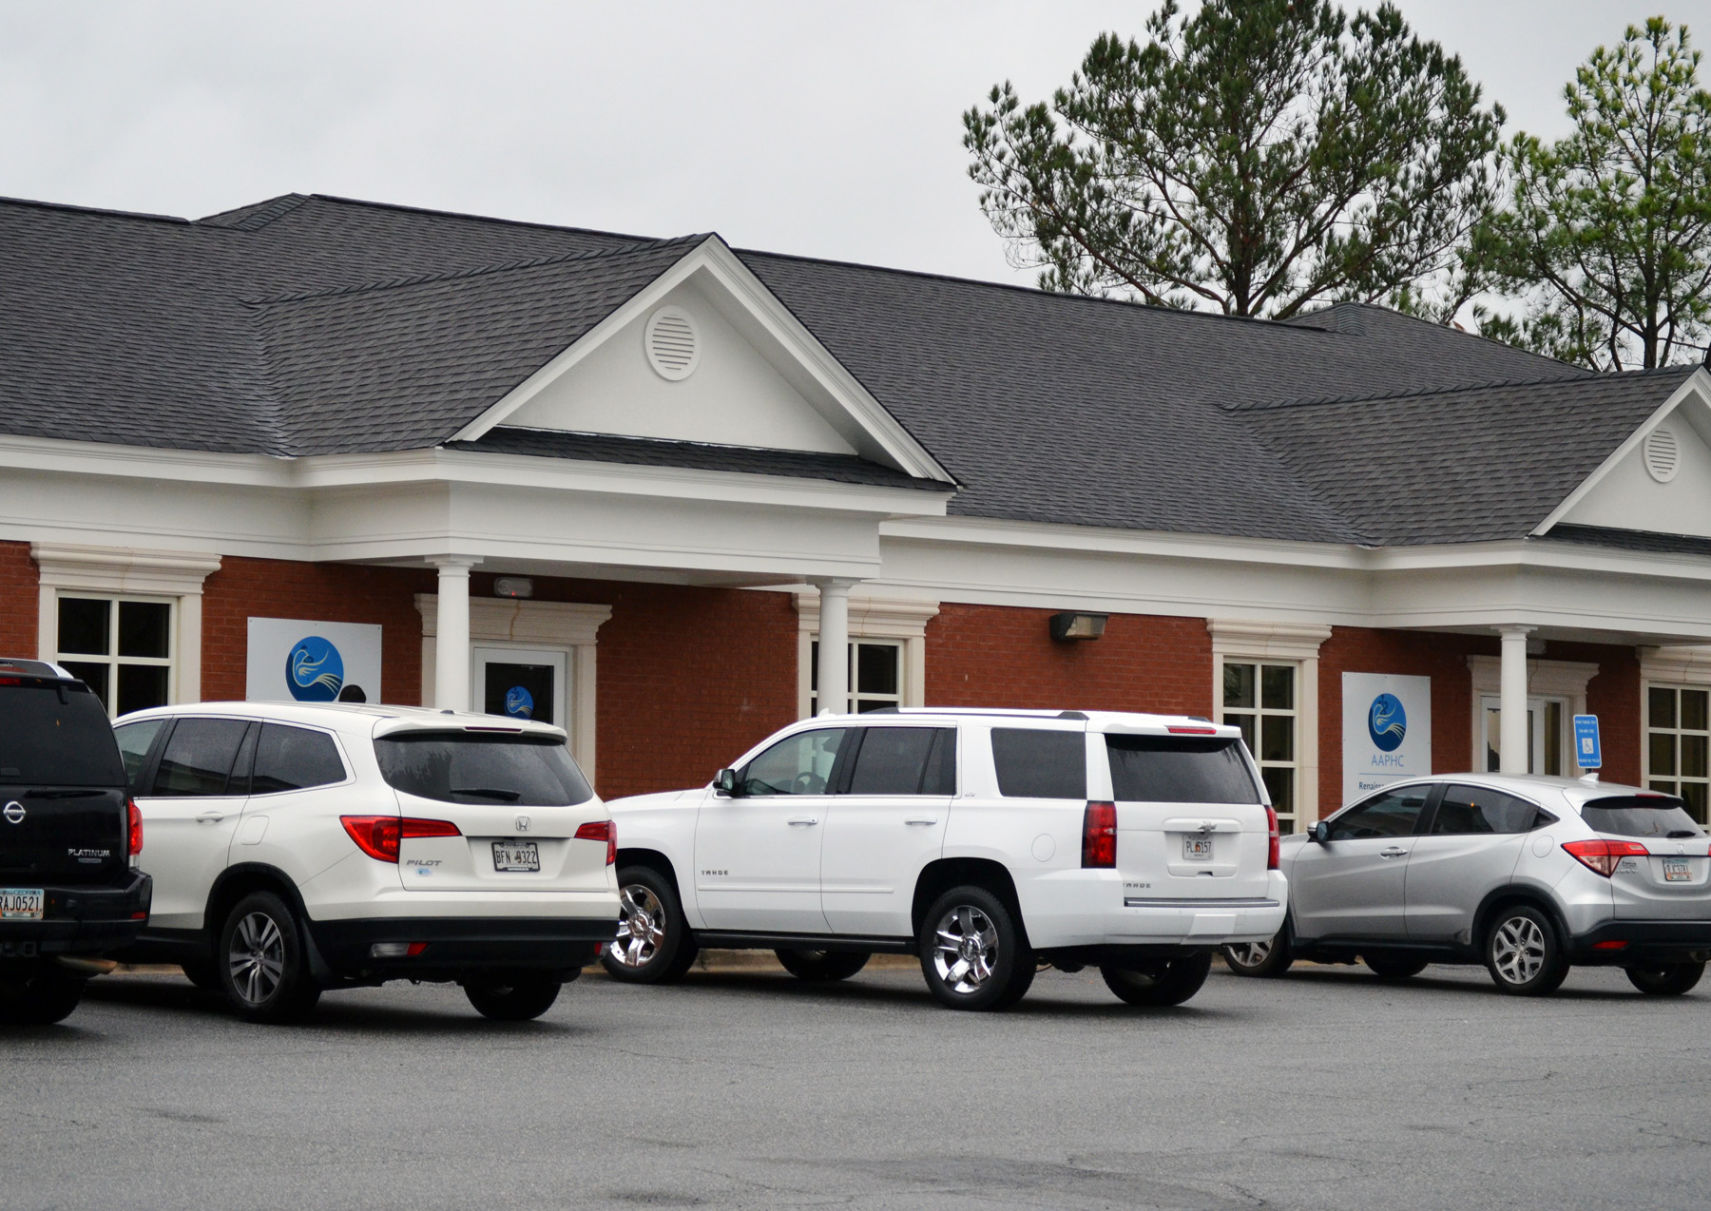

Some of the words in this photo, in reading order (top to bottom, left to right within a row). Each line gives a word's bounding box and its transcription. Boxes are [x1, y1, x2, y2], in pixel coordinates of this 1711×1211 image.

[1371, 754, 1405, 767] AAPHC
[67, 848, 111, 857] PLATINUM
[495, 850, 511, 864] BFN
